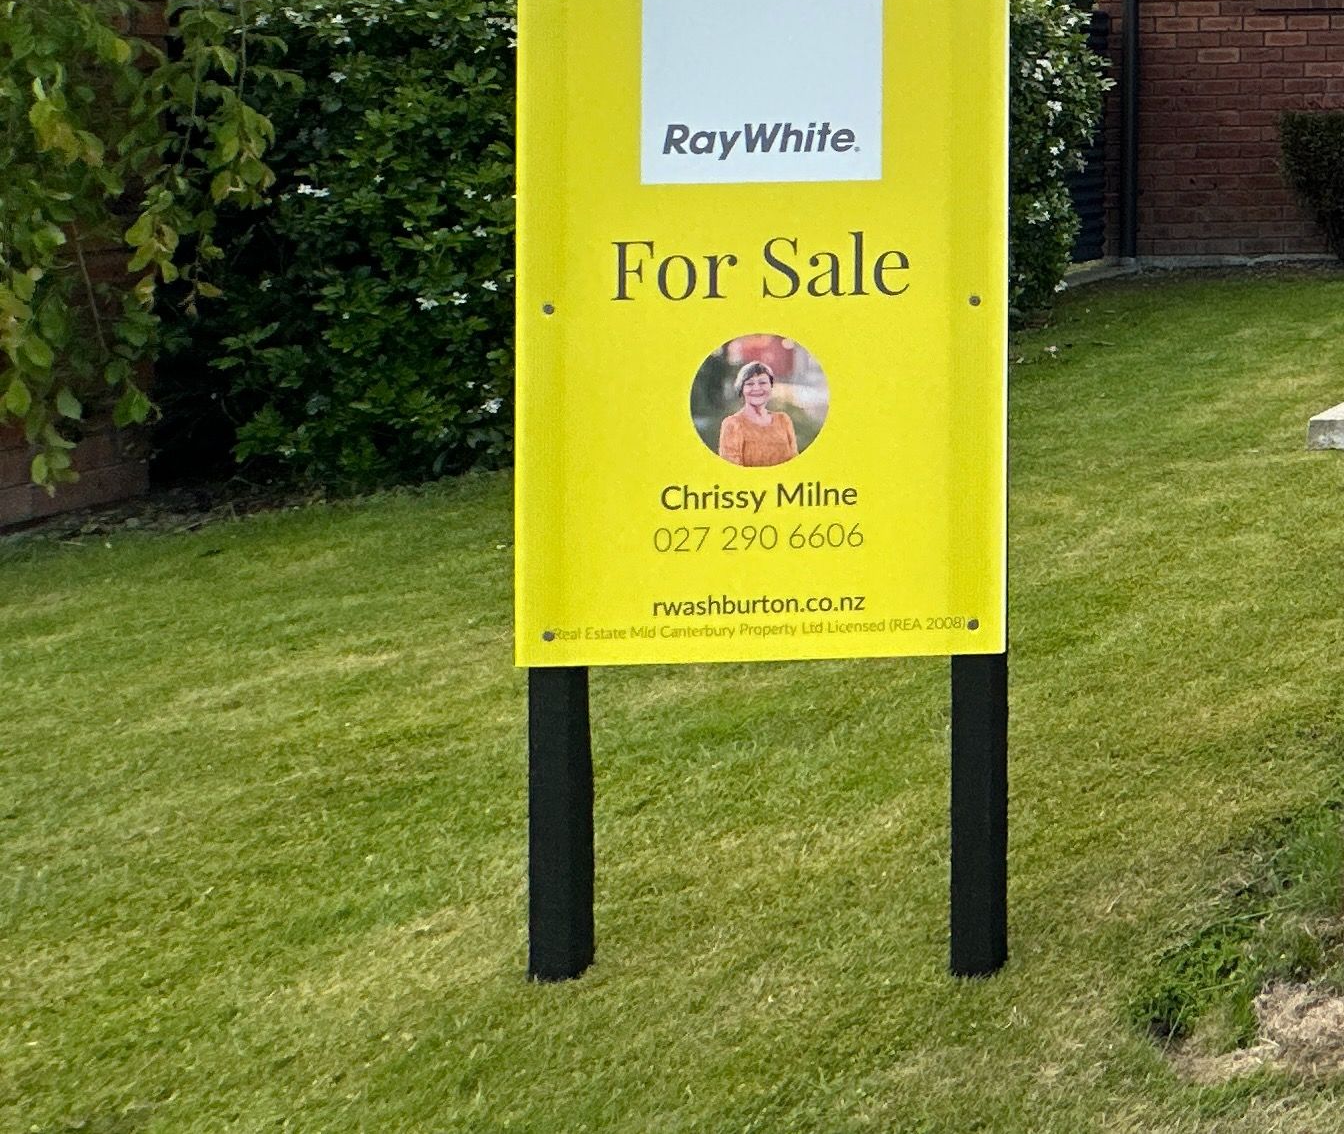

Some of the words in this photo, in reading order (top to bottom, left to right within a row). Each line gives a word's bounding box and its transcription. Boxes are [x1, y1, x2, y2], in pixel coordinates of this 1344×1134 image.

[611, 240, 738, 301] For
[762, 231, 910, 299] Sale
[660, 483, 767, 514] Chrissy
[777, 481, 858, 508] Milne
[653, 526, 711, 553] 027
[722, 525, 779, 551] 290
[789, 522, 865, 549] 6606
[652, 594, 866, 617] rwashburton.co.nz
[554, 627, 582, 641] Real
[584, 626, 627, 640] Estate
[630, 624, 656, 639] Mid
[660, 624, 736, 639] Canterbury
[739, 622, 797, 638] Property
[801, 621, 824, 634] Ltd
[828, 619, 886, 633] Licensed
[889, 618, 923, 633] (REA
[926, 616, 966, 632] 2008)
